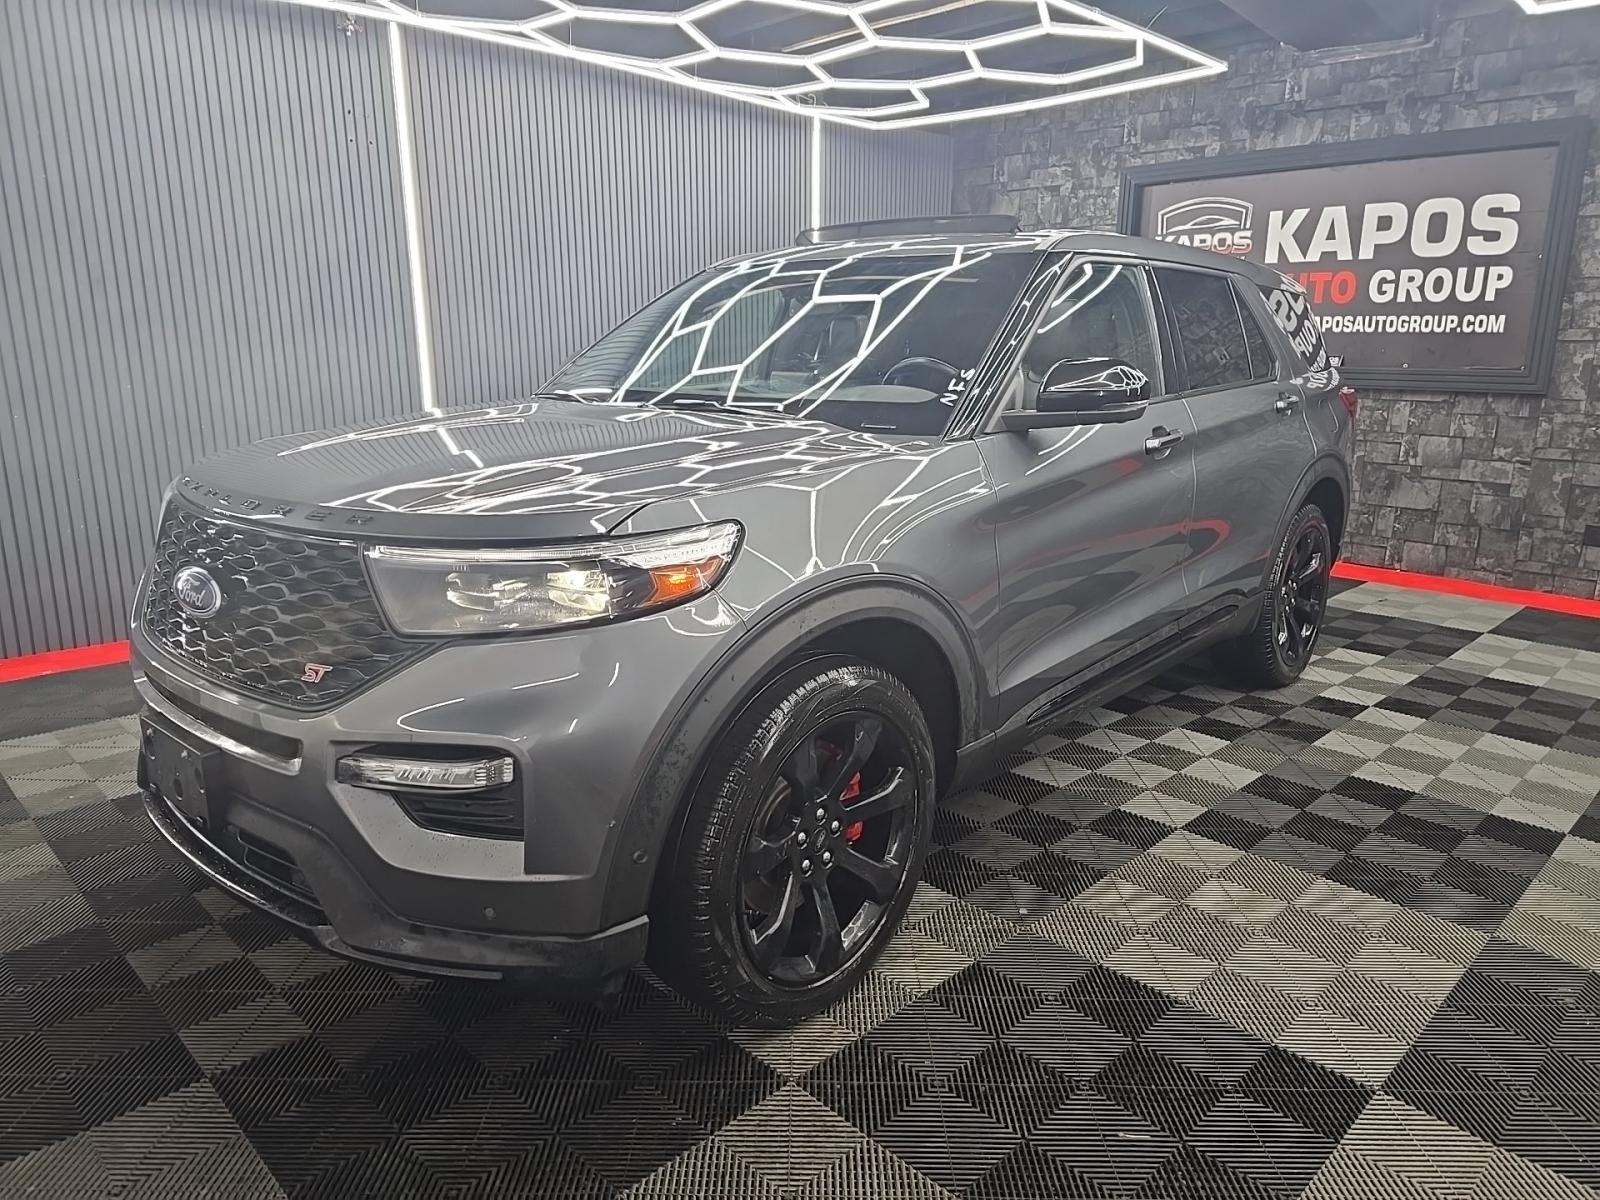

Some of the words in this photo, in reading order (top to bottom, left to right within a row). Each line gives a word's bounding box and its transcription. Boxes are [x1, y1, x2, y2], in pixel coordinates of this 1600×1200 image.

[1265, 193, 1521, 264] KAPOS
[1154, 231, 1253, 255] POS
[1369, 266, 1513, 303] GROUP
[1314, 314, 1506, 333] POSAUTOGROUP.COM
[178, 576, 206, 607] Ford
[301, 663, 333, 683] ST
